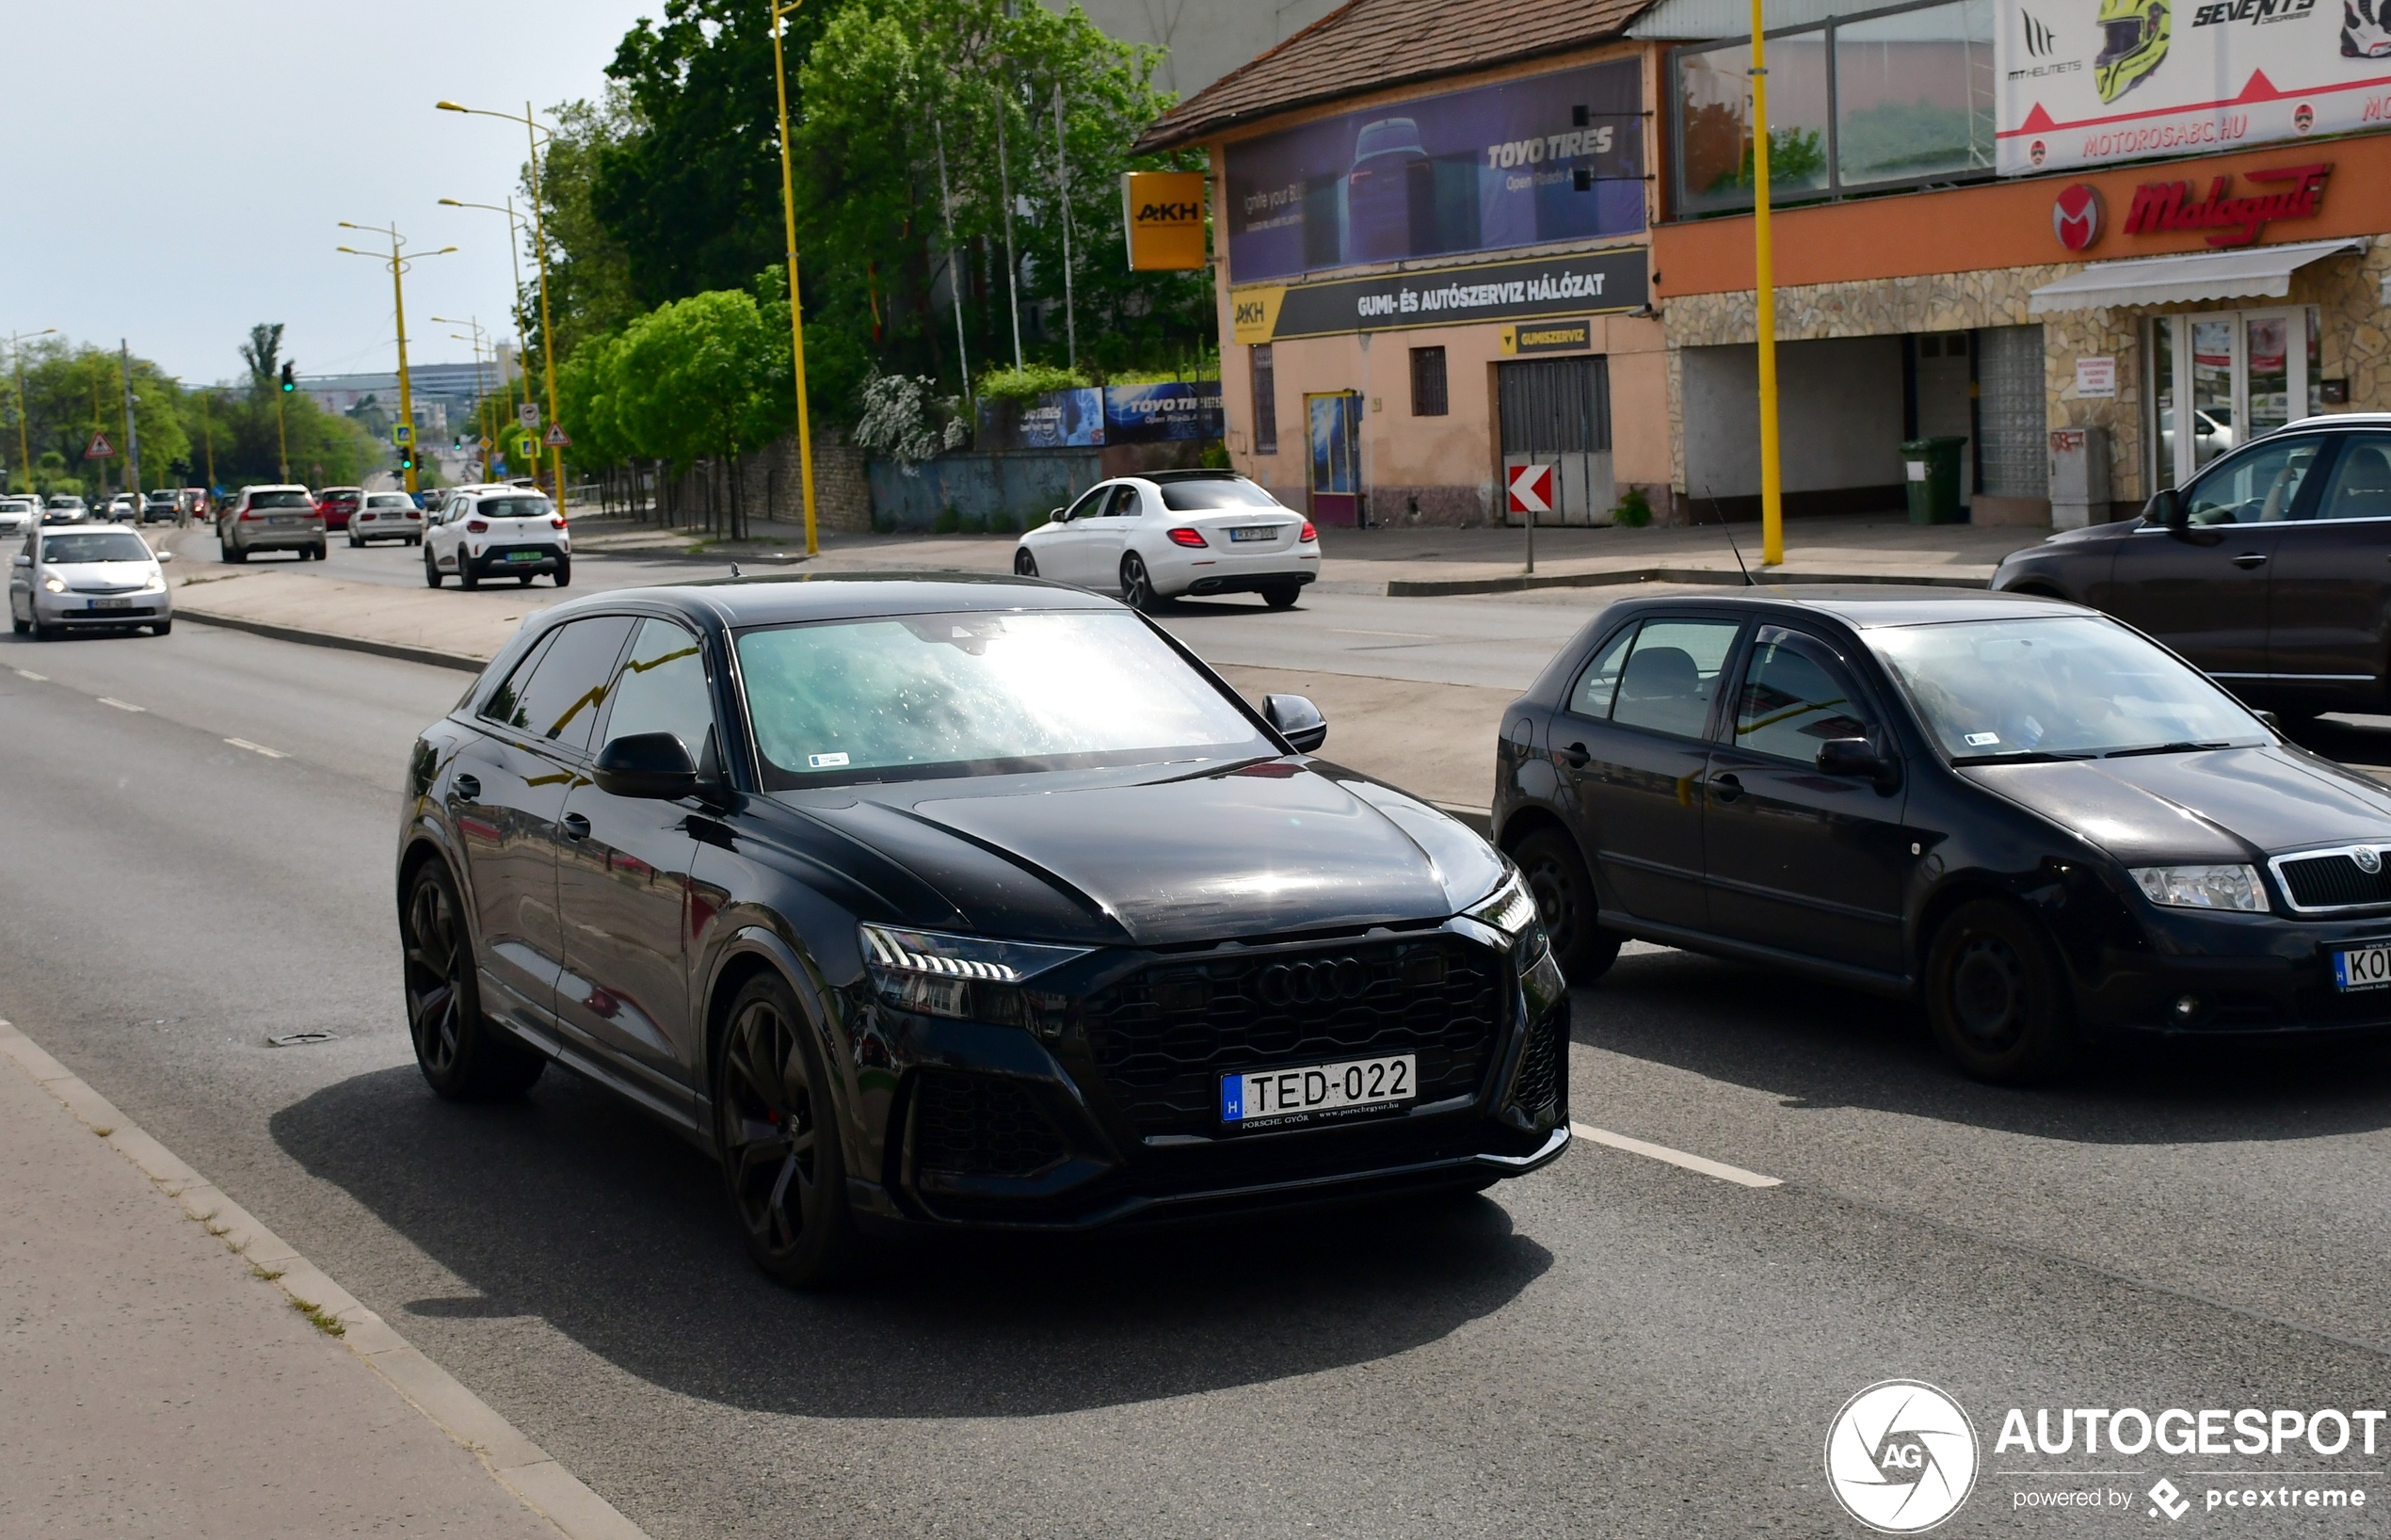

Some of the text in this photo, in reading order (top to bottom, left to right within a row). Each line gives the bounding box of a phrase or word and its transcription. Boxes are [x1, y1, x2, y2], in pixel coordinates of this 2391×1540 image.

[1487, 126, 1613, 169] TOYO TIRES
[2083, 114, 2247, 158] MOTOROSABC.HU
[1506, 175, 1532, 192] Open
[1135, 201, 1198, 221] AKH
[2124, 164, 2328, 246] Malaguti
[1357, 271, 1605, 316] GUMI- ÉS AUTÓSZERVIZ HÁLÓZAT
[1520, 329, 1585, 345] GUMISZERVIZ
[1131, 397, 1176, 413] TOYO
[2336, 950, 2391, 982] H KO
[1228, 1060, 1407, 1114] H TED-022
[1242, 1117, 1283, 1129] PORSCHE
